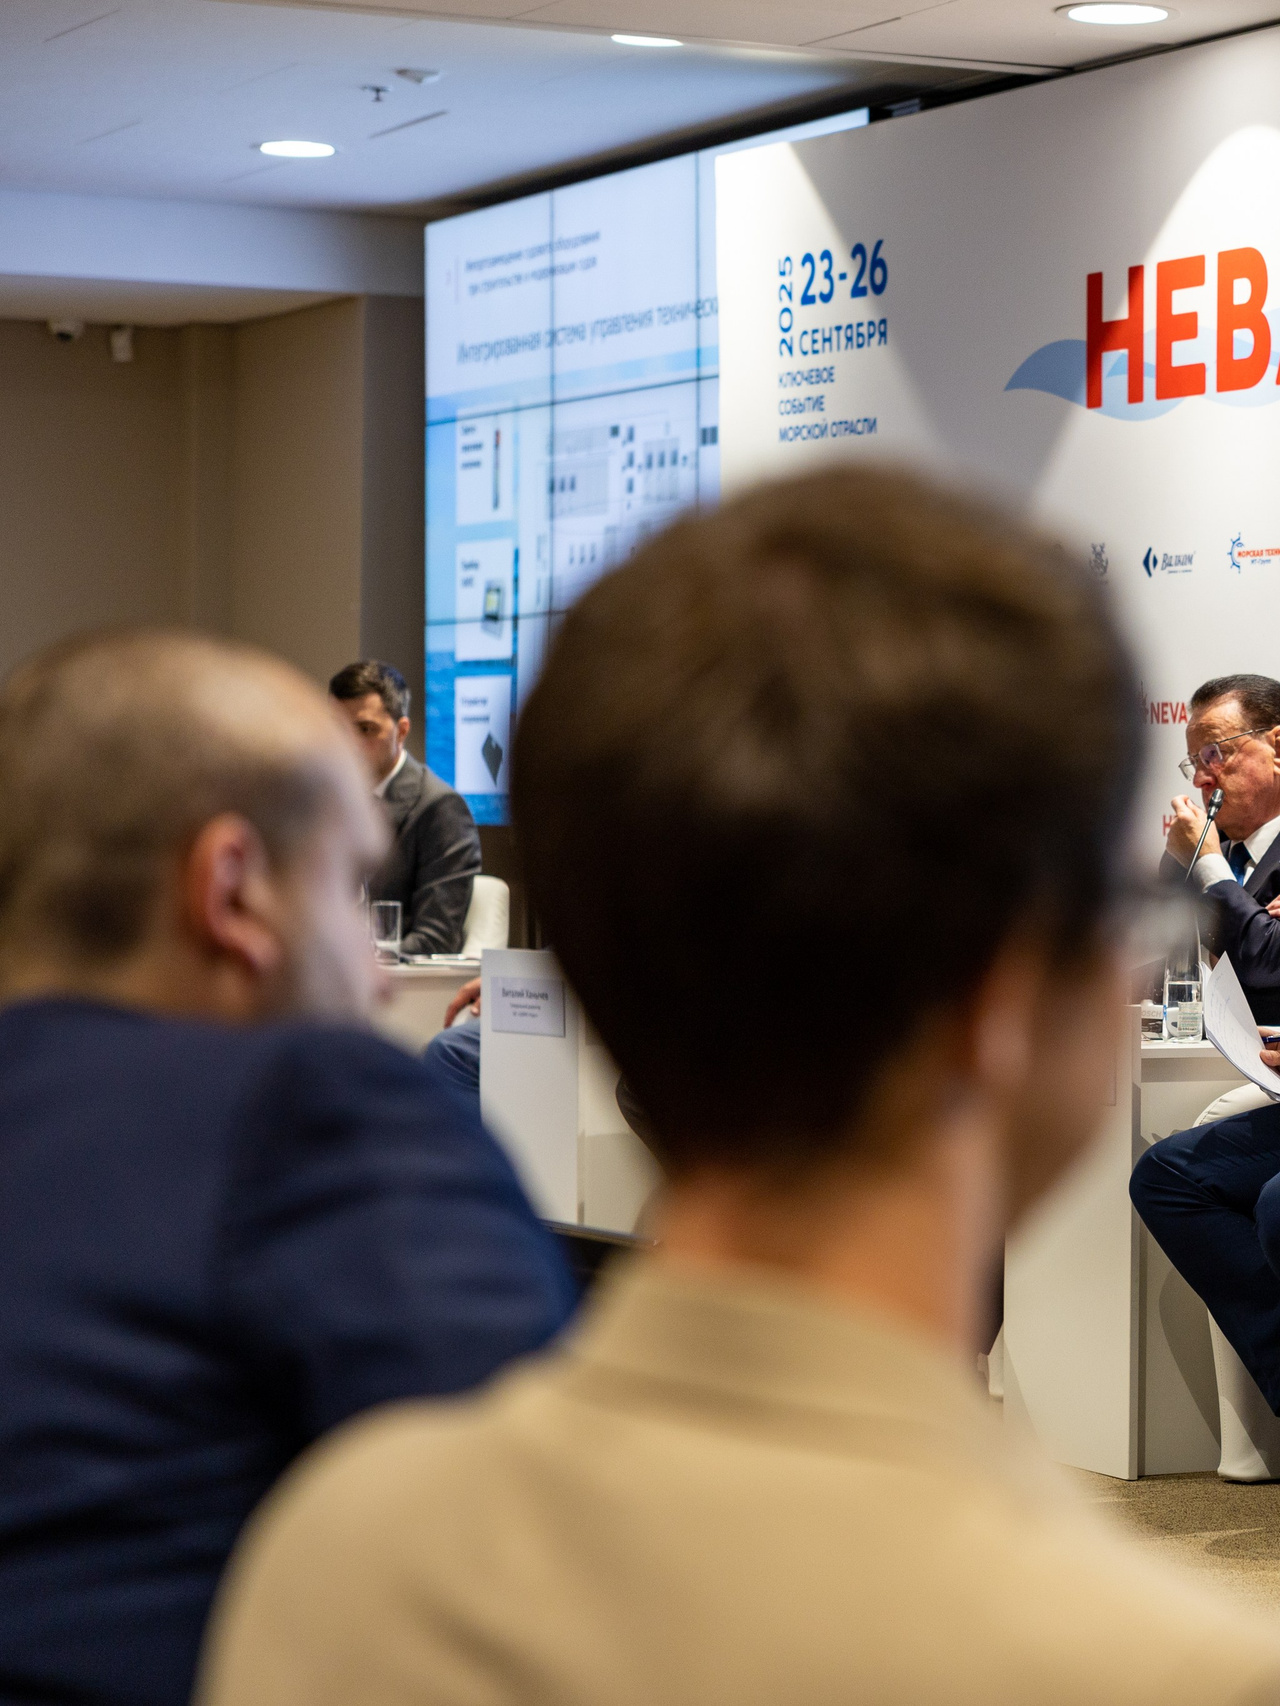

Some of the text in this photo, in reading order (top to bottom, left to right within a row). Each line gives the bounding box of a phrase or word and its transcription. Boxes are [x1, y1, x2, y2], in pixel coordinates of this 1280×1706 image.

[800, 239, 888, 306] 23-26
[778, 255, 794, 358] 2025
[799, 317, 888, 356] СЕНТЯБРЯ
[778, 365, 835, 389] КЛЮЧЕВОЕ
[778, 395, 825, 416] СОБЫТИЕ
[778, 417, 878, 443] МОРСКОЙ ОТРАСЛИ
[1150, 702, 1188, 725] NEVA
